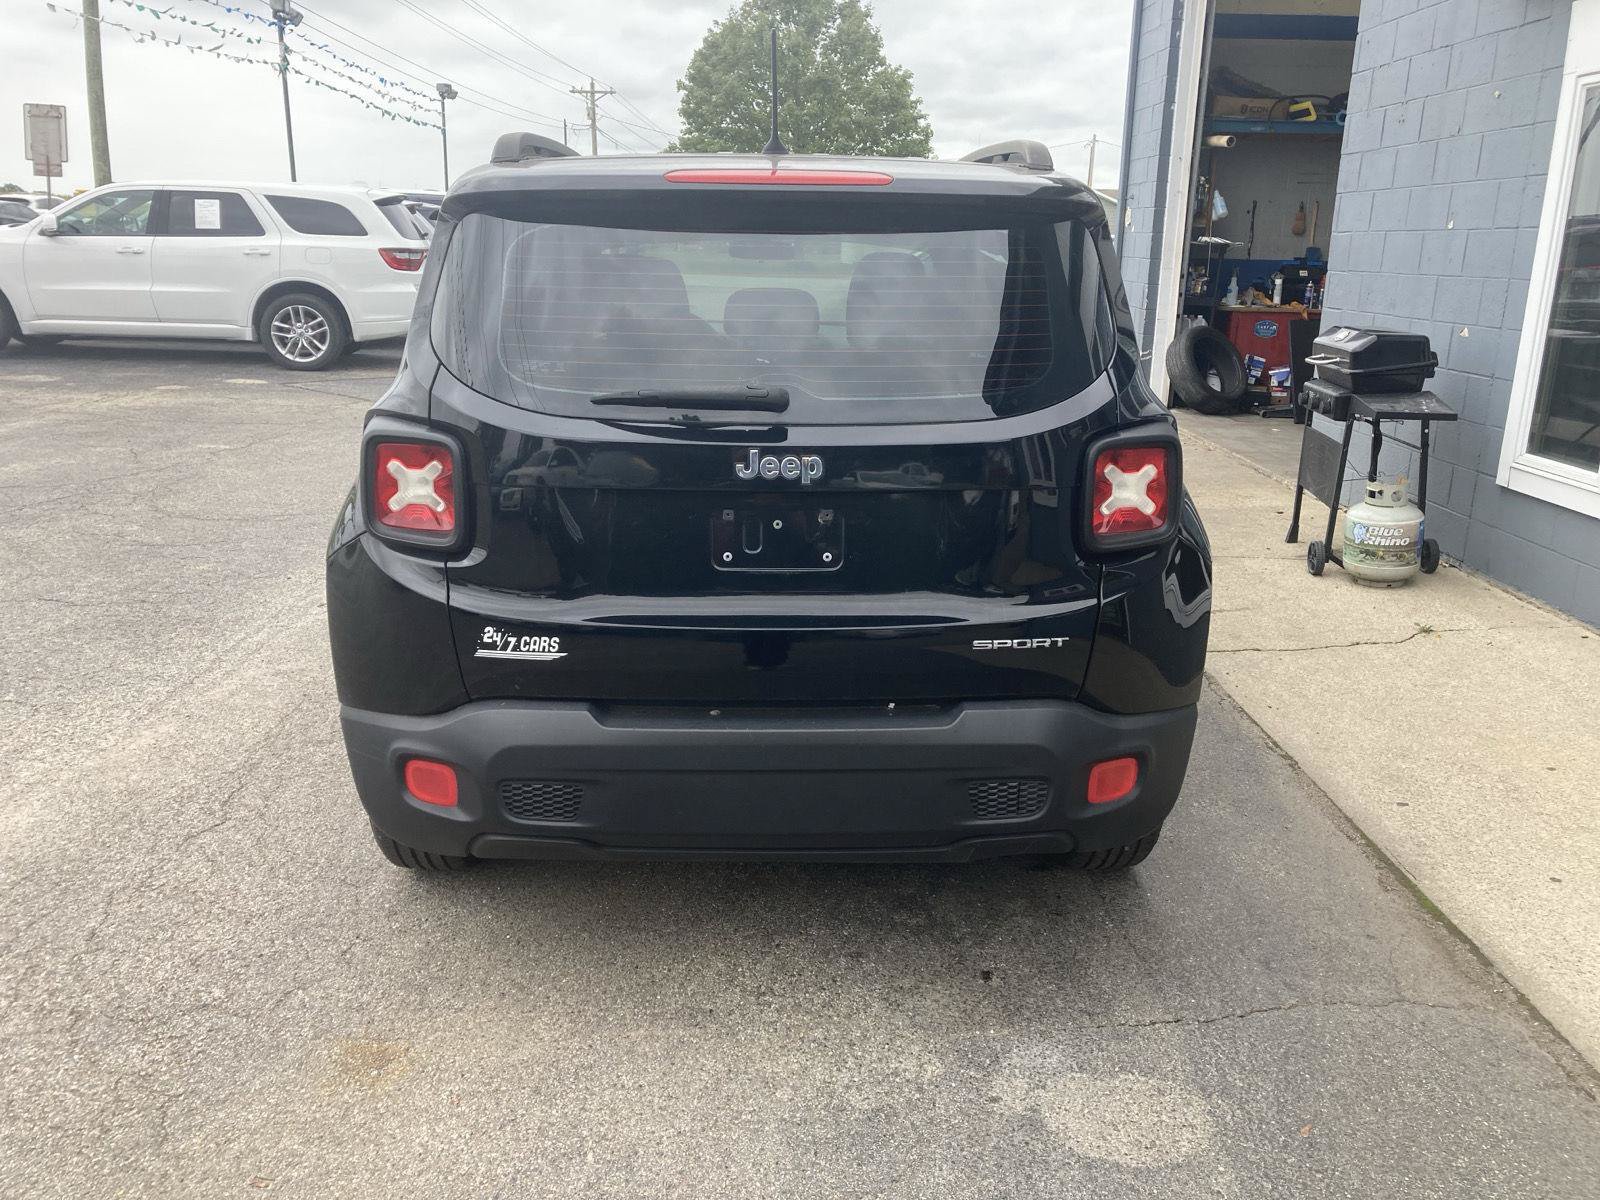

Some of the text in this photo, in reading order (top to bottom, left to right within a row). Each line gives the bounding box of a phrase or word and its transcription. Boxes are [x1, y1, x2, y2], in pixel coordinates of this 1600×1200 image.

[735, 448, 823, 484] Jeep
[1368, 526, 1404, 537] Blue
[1364, 535, 1411, 546] Rhino
[482, 625, 560, 653] 24/7 CARS
[972, 637, 1070, 650] SPORT
